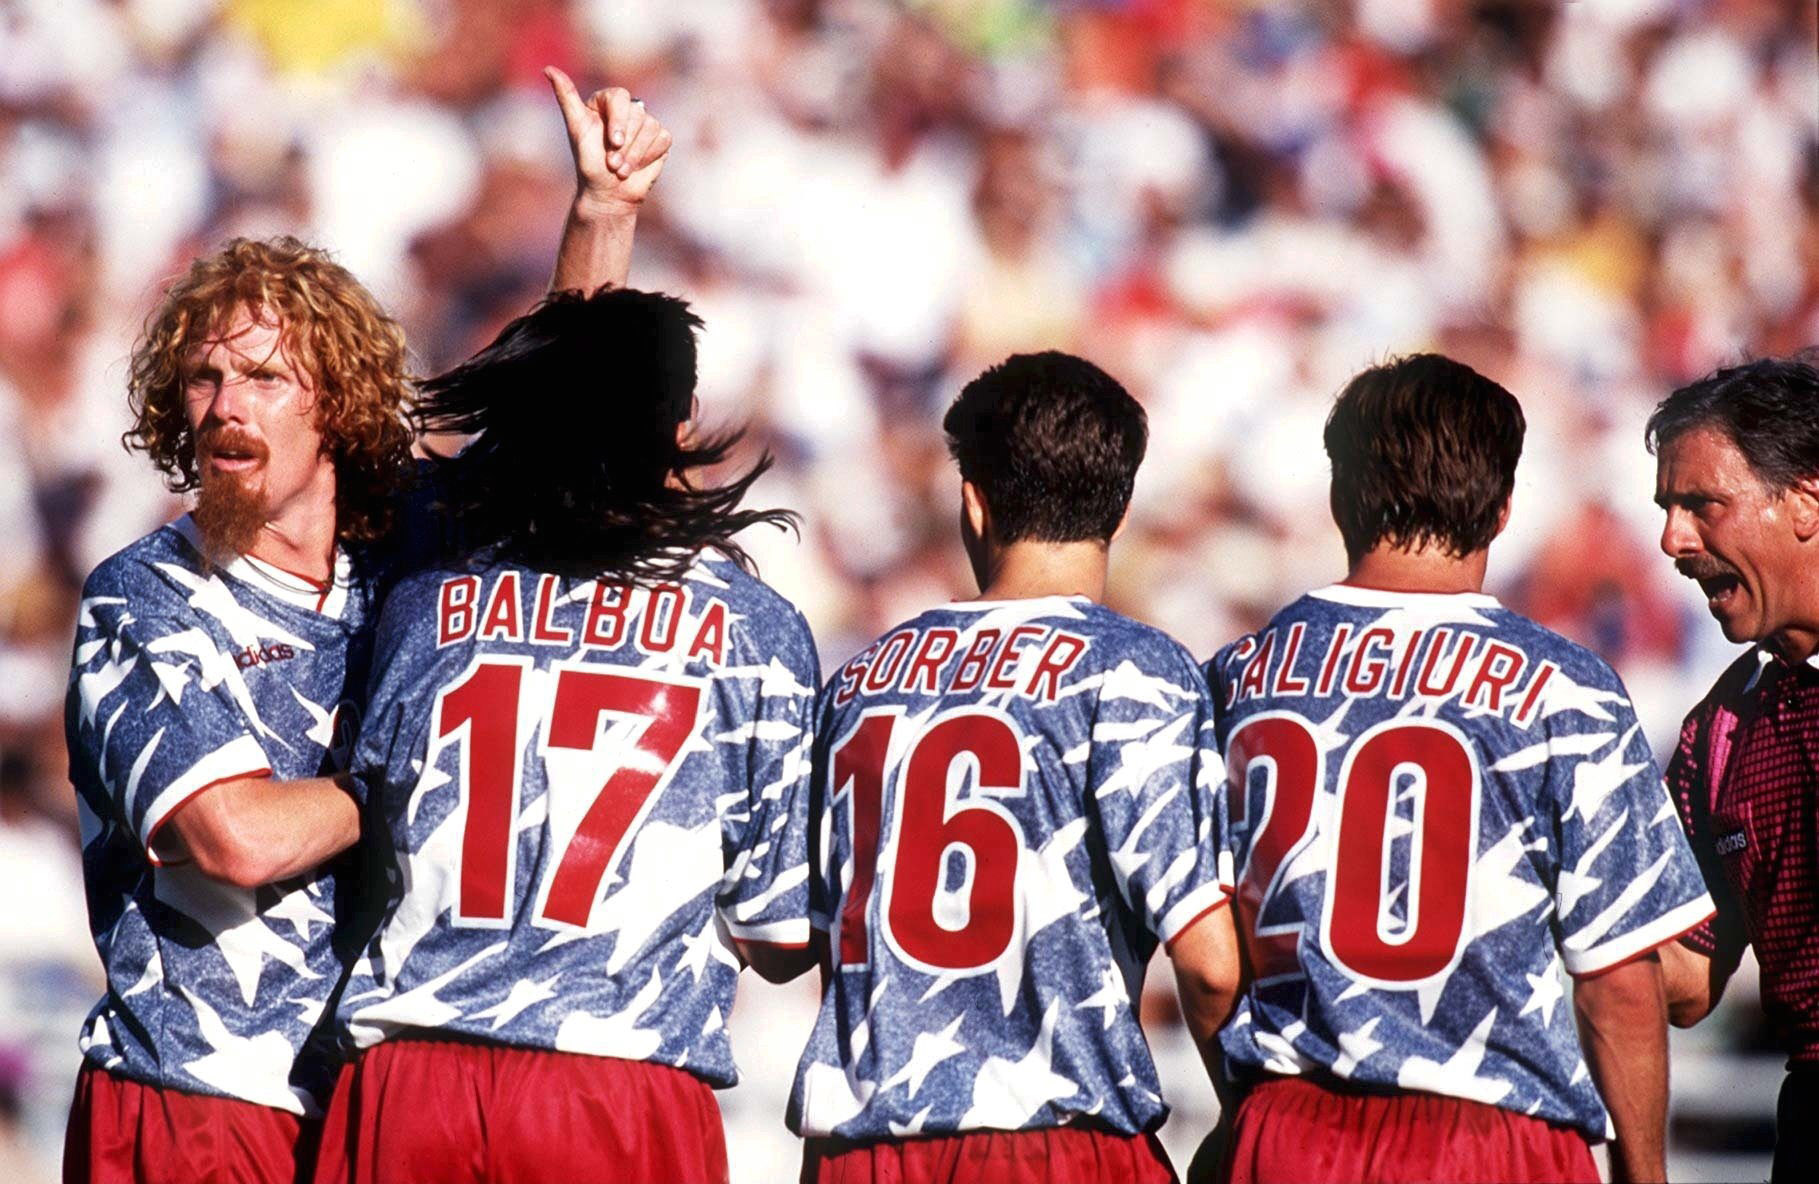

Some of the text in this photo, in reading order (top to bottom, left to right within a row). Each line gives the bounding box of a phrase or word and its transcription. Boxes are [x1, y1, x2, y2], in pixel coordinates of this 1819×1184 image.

[437, 570, 732, 667] BALBOA
[834, 625, 1089, 708] SORBER
[430, 654, 711, 930] 17
[830, 704, 1027, 975] 16
[1225, 709, 1482, 991] 20
